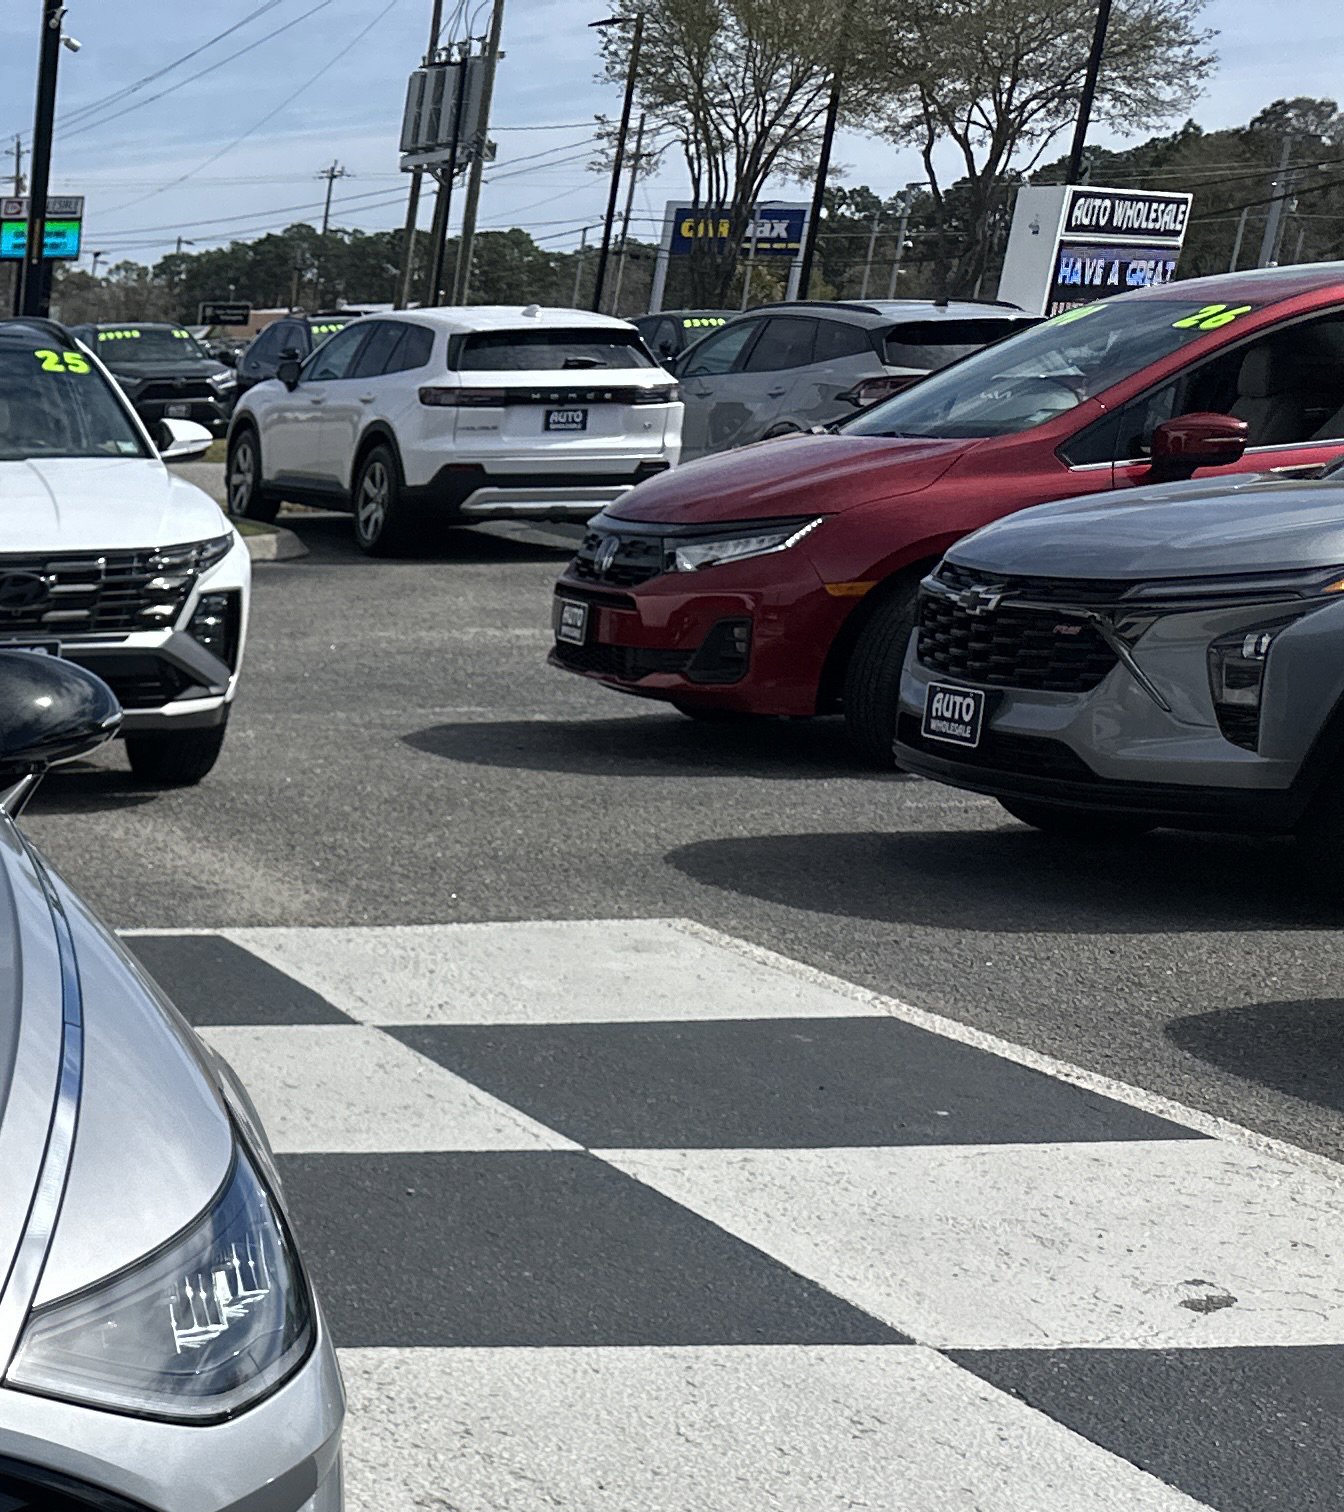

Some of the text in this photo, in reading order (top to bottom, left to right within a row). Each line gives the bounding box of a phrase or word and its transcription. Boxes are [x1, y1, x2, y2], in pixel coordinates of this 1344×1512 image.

[1071, 197, 1186, 232] AUTO WHOLESALE
[1058, 257, 1175, 287] HAVE A GREAT
[1172, 304, 1252, 331] 26
[34, 349, 91, 375] 25
[550, 410, 583, 423] AUTO
[932, 692, 975, 722] AUTO
[929, 718, 972, 738] WHOLESALE
